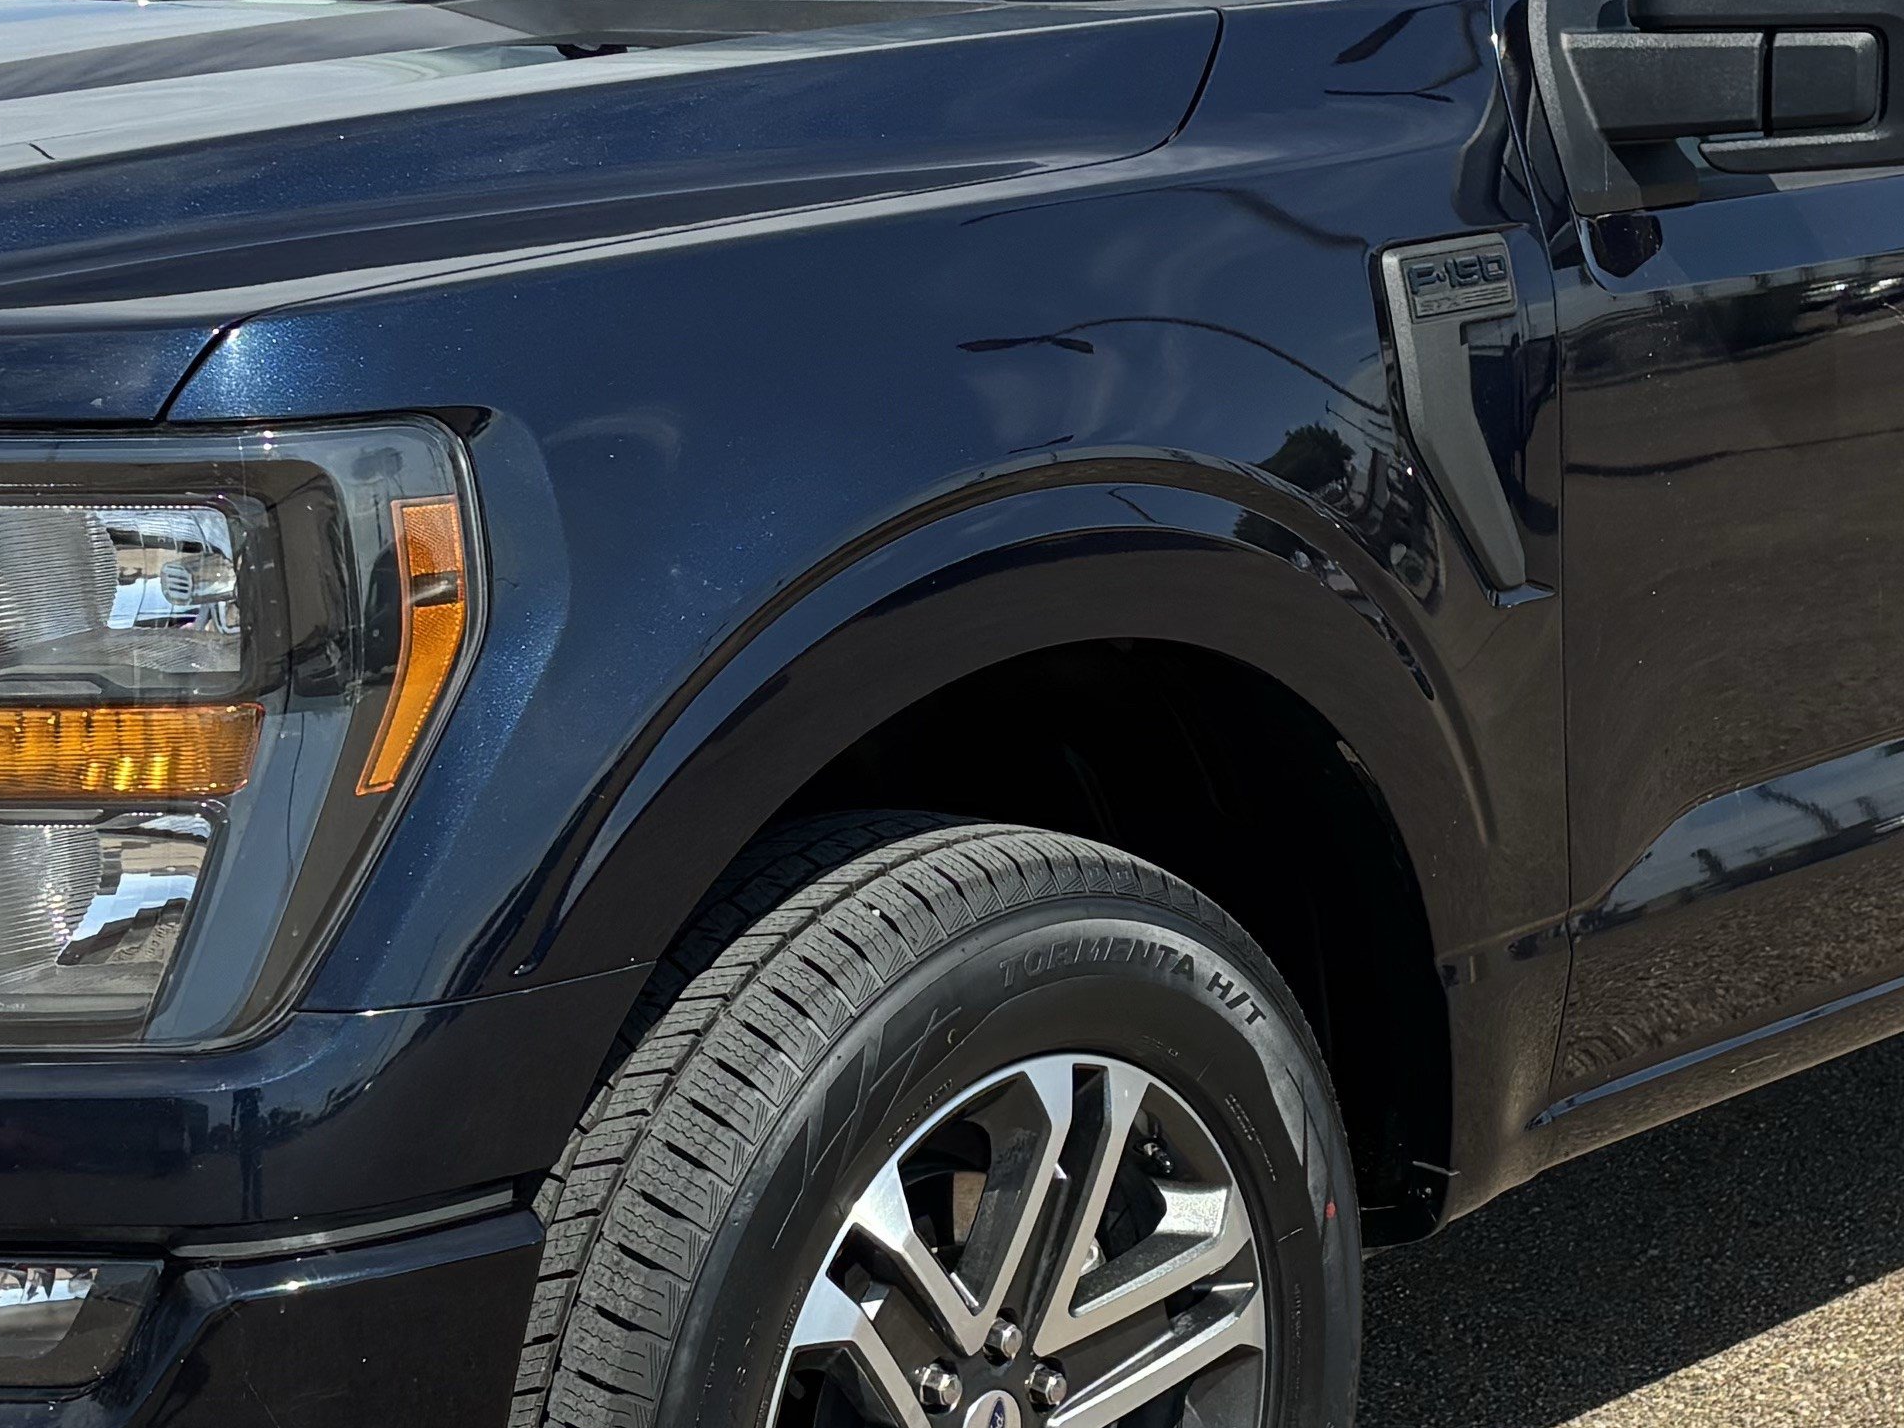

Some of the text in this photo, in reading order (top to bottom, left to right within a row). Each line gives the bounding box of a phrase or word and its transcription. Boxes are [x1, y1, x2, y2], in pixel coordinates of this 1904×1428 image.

[1407, 254, 1508, 296] F-150
[998, 936, 1267, 1026] TORMENTA H/T
